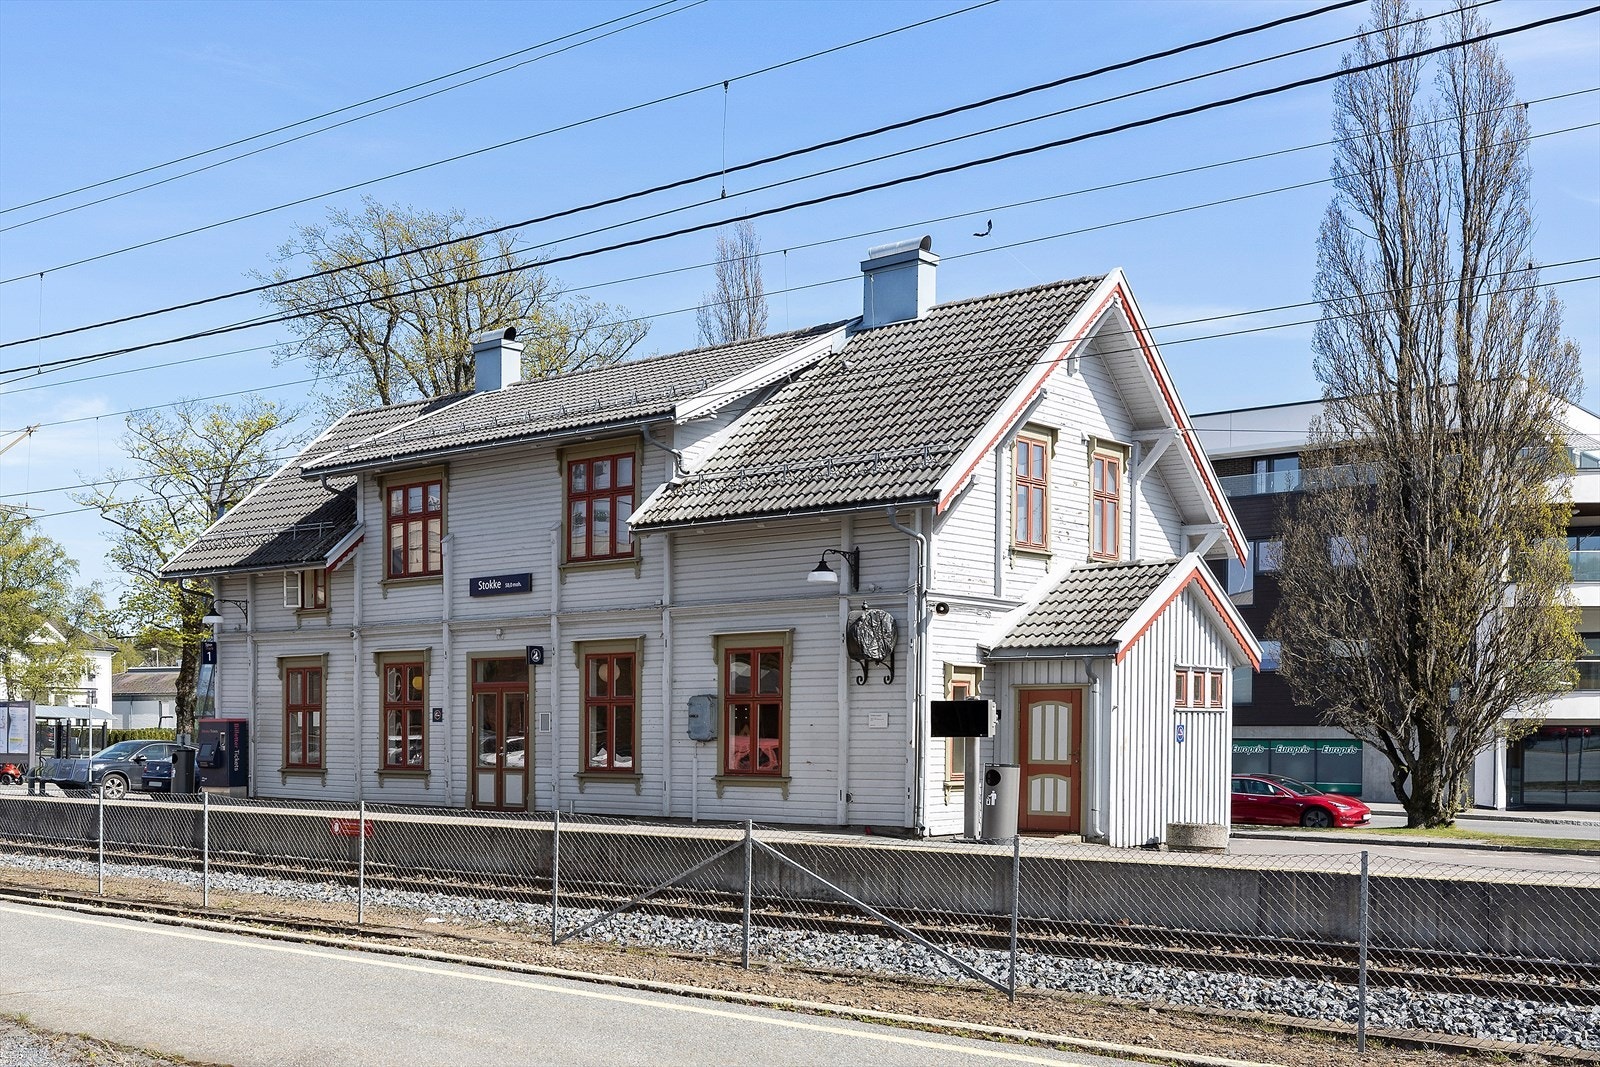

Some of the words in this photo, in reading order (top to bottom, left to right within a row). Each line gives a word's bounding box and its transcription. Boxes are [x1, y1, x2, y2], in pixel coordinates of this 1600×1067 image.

[478, 580, 502, 590] Stokke
[207, 651, 211, 662] 1
[1232, 744, 1265, 755] Europris
[1275, 744, 1310, 755] Europris
[1321, 745, 1357, 756] Europris
